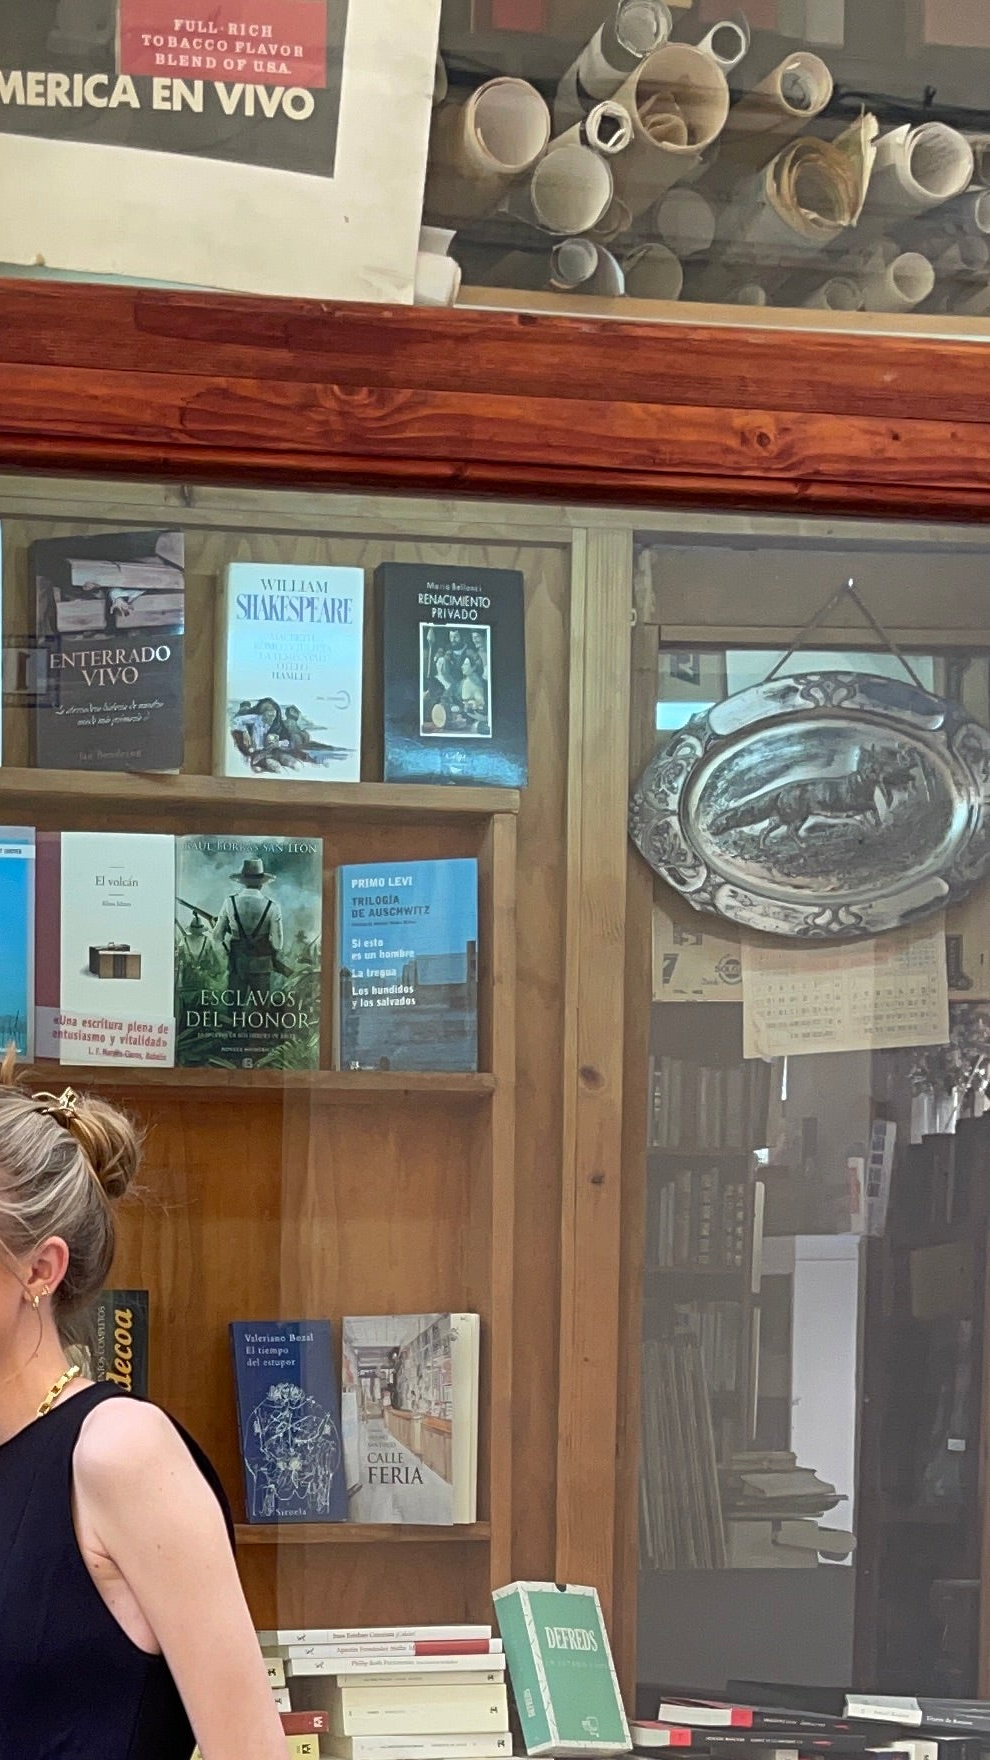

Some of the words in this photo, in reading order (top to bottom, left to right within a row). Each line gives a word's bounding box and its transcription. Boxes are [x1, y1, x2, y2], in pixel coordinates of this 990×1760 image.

[141, 34, 227, 53] TOBACCO
[233, 41, 304, 58] FLAVOR
[154, 52, 216, 70] BLEND
[222, 57, 247, 71] OF
[152, 78, 203, 113] EN
[216, 80, 314, 121] VIVO
[260, 578, 329, 594] WILLIAM
[418, 593, 492, 609] RENACIMIENTO
[235, 593, 354, 625] SHAKESPEARE
[431, 607, 479, 621] PRIVADO
[50, 645, 171, 670] ENTERRADO
[81, 666, 139, 687] VIVO
[272, 671, 313, 681] HAMLET
[95, 875, 106, 887] El
[108, 874, 139, 888] volcán
[351, 877, 386, 889] PRIMO
[388, 876, 414, 888] LEVI
[351, 907, 365, 919] DE
[368, 905, 431, 918] AUSCHWITZ
[351, 937, 361, 949] Si
[363, 938, 384, 949] esto
[364, 951, 377, 961] un
[378, 948, 416, 961] hombre
[351, 967, 364, 979] La
[365, 968, 398, 981] tregua
[351, 985, 369, 997] Los
[370, 984, 414, 997] hundidos
[200, 990, 297, 1007] ESCLAVOS
[351, 1000, 359, 1010] y
[359, 997, 375, 1009] los
[376, 996, 417, 1008] salvados
[82, 1018, 124, 1031] escritura
[127, 1021, 154, 1034] plena
[157, 1023, 170, 1035] de
[186, 1011, 223, 1029] DEL
[232, 1011, 310, 1029] HONOR
[51, 1029, 106, 1043] entusiasmo
[109, 1035, 116, 1046] y
[244, 1332, 286, 1344] Valeriano
[288, 1332, 314, 1343] Bozal
[245, 1345, 256, 1355] El
[257, 1346, 289, 1358] tiempo
[246, 1358, 261, 1368] del
[263, 1358, 297, 1370] estupor
[367, 1452, 404, 1464] CALLE
[368, 1466, 425, 1485] FERIA
[275, 1506, 308, 1518] Siruela
[544, 1626, 599, 1653] DEFREDS
